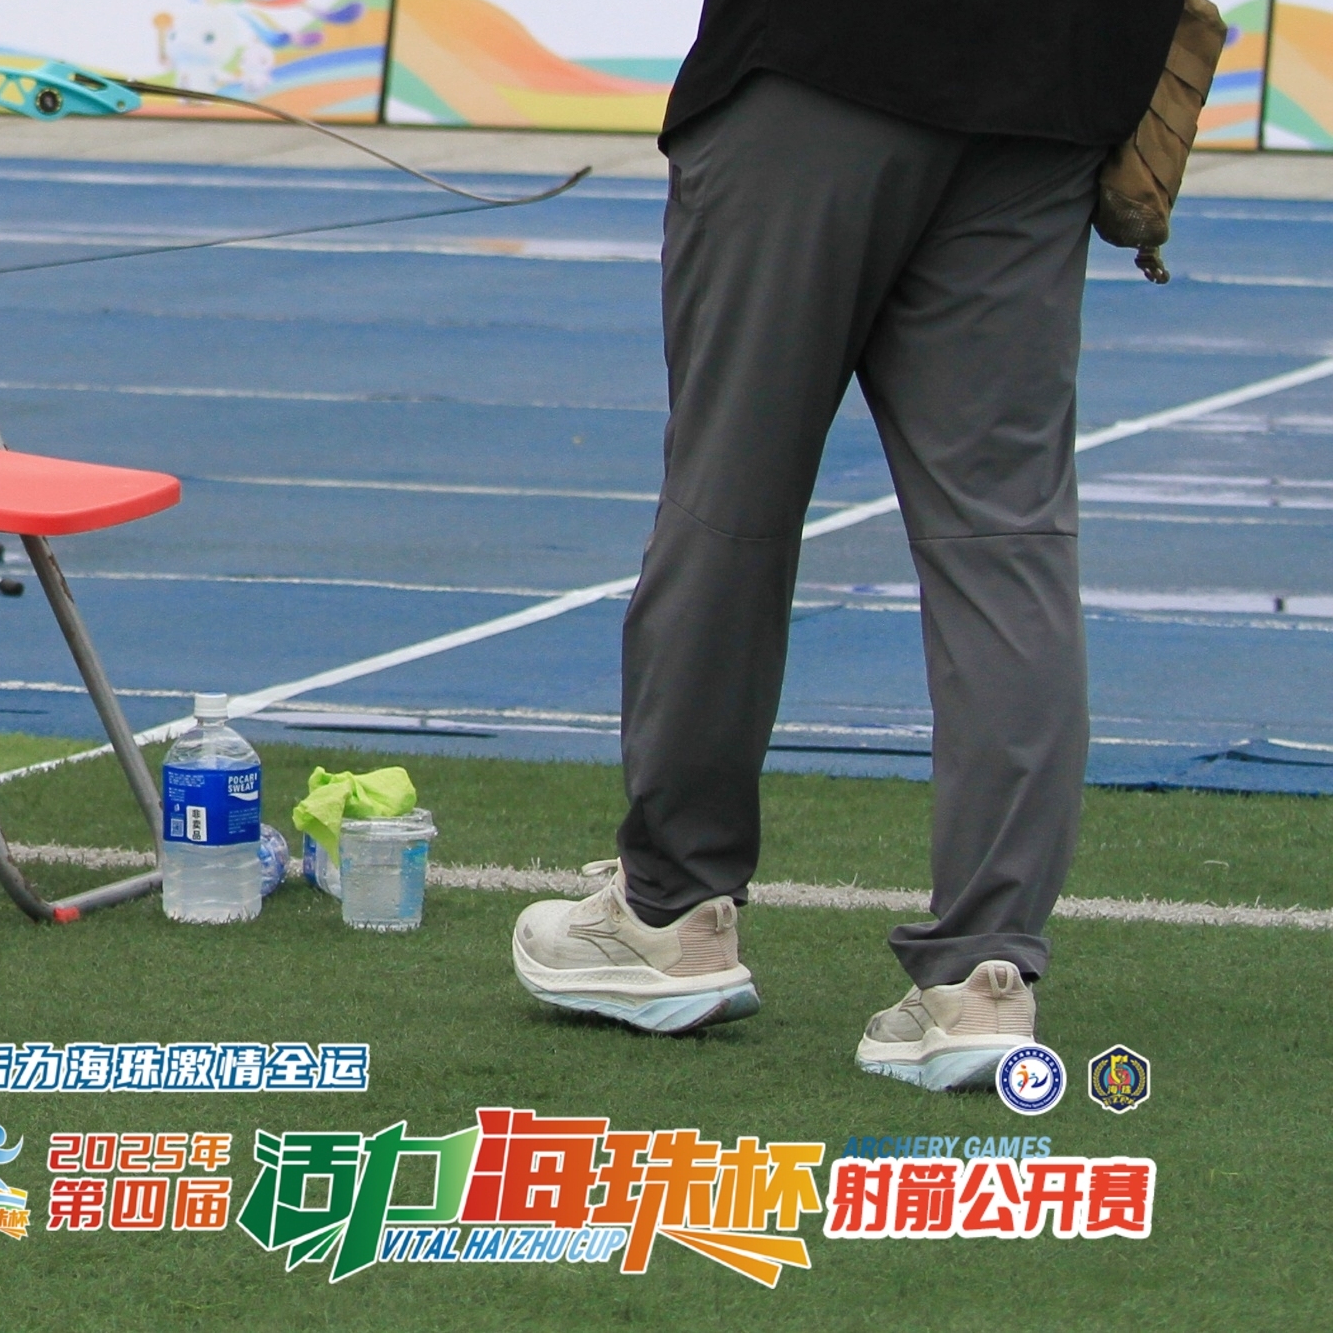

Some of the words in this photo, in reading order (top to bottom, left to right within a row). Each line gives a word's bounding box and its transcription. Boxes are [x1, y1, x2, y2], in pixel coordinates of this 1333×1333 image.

[228, 773, 258, 784] POCARI
[228, 782, 254, 793] SWEAT
[191, 808, 202, 841] 非卖品
